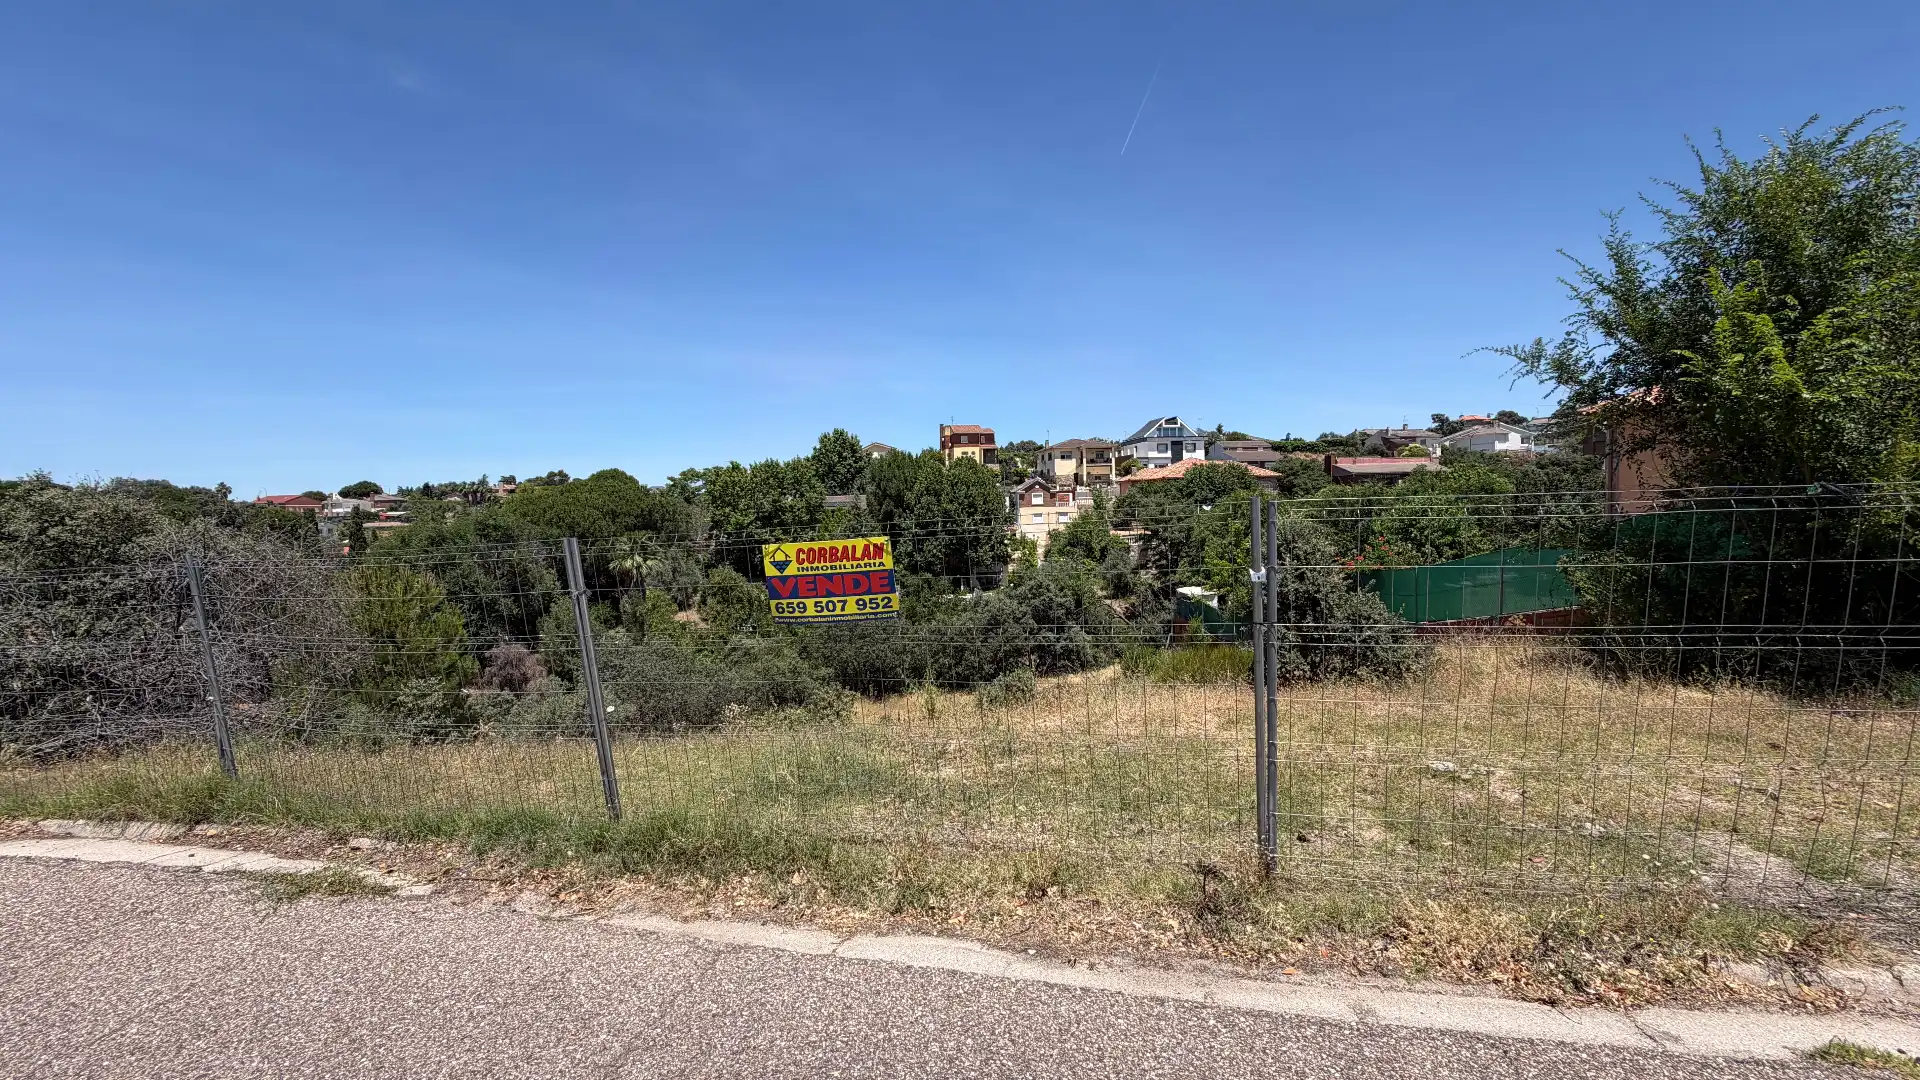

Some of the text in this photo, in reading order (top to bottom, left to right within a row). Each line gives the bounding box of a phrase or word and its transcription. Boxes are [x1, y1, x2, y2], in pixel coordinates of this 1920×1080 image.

[796, 543, 884, 565] CORBALAN
[797, 562, 886, 573] INMOBILIARIA
[772, 572, 891, 598] VENDE
[775, 596, 893, 614] 659 507 952
[777, 613, 894, 623] www.corbalaninmobiliaria.com
